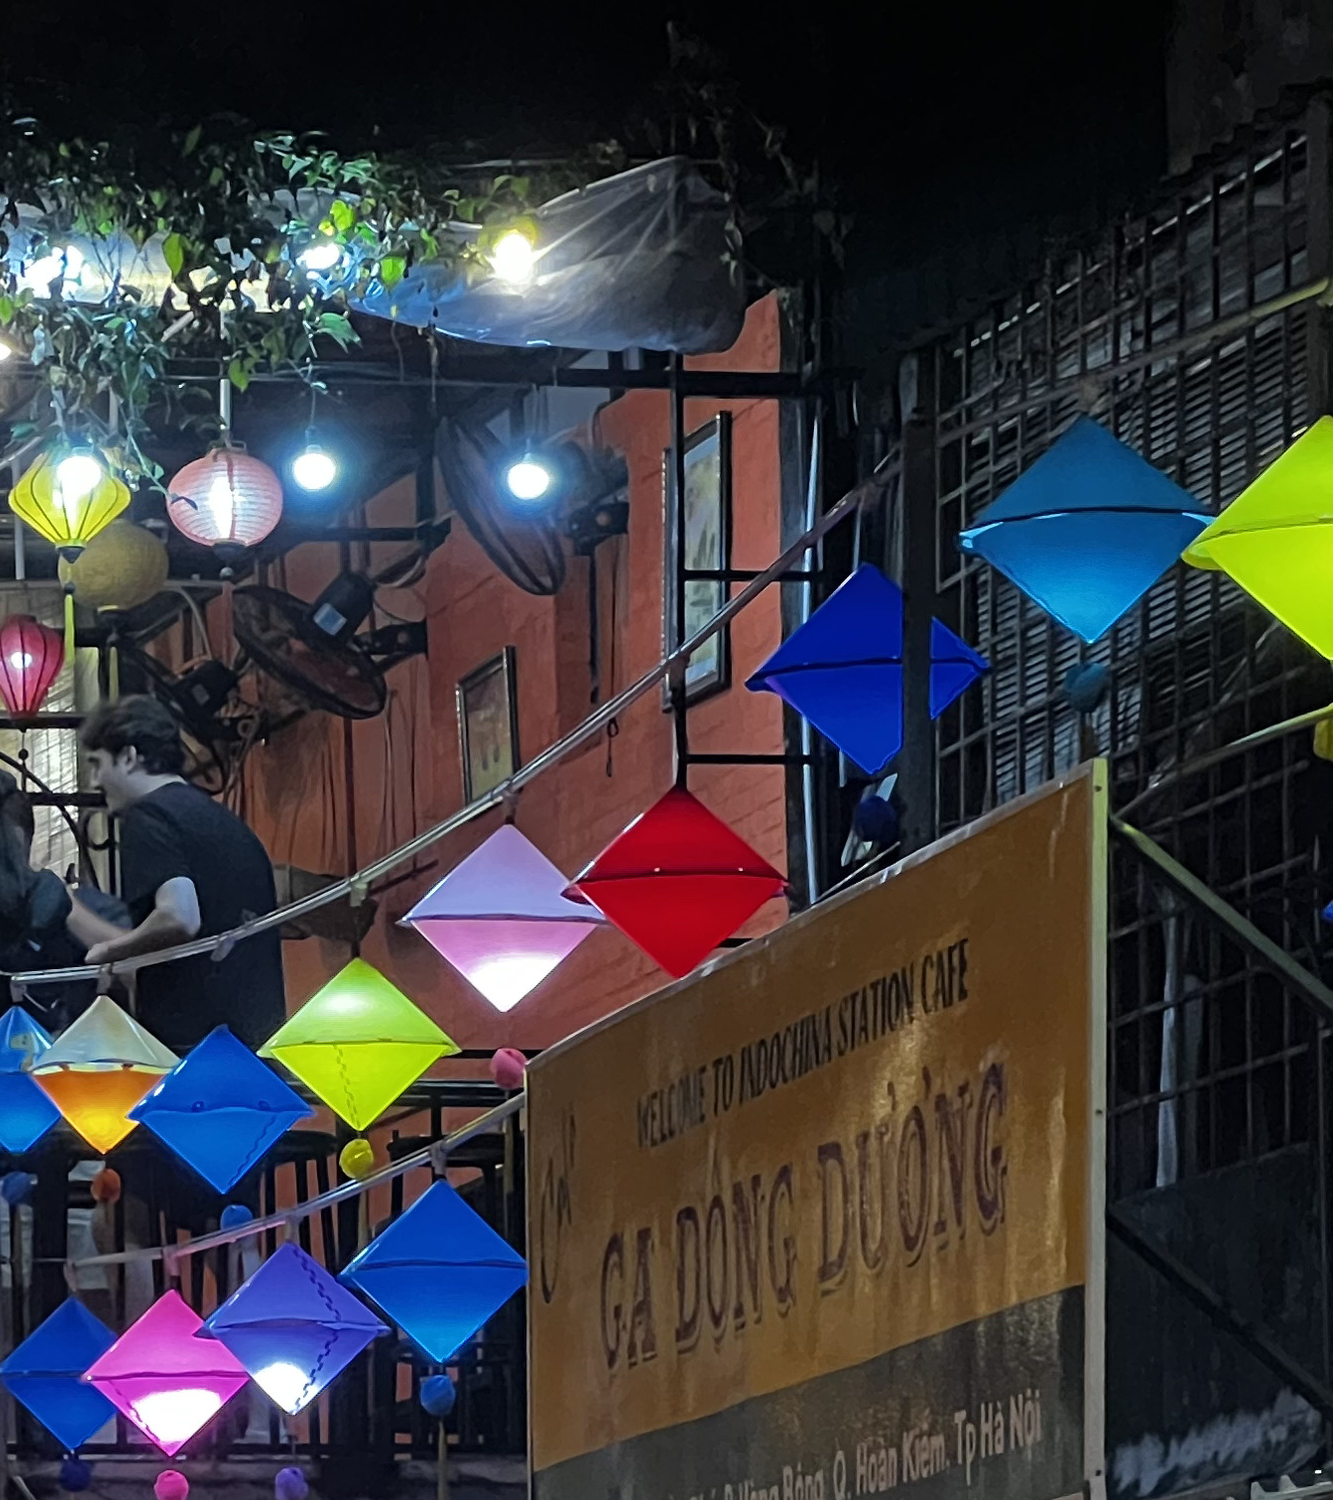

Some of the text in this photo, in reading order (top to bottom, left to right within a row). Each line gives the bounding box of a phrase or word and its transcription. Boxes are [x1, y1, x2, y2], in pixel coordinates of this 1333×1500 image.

[636, 937, 970, 1148] WELCOME TO INDOCHINA STATION CAFE
[600, 1226, 657, 1372] GA
[953, 1409, 977, 1487] Tp
[980, 1400, 1006, 1458] Hà
[1009, 1387, 1042, 1461] Nội
